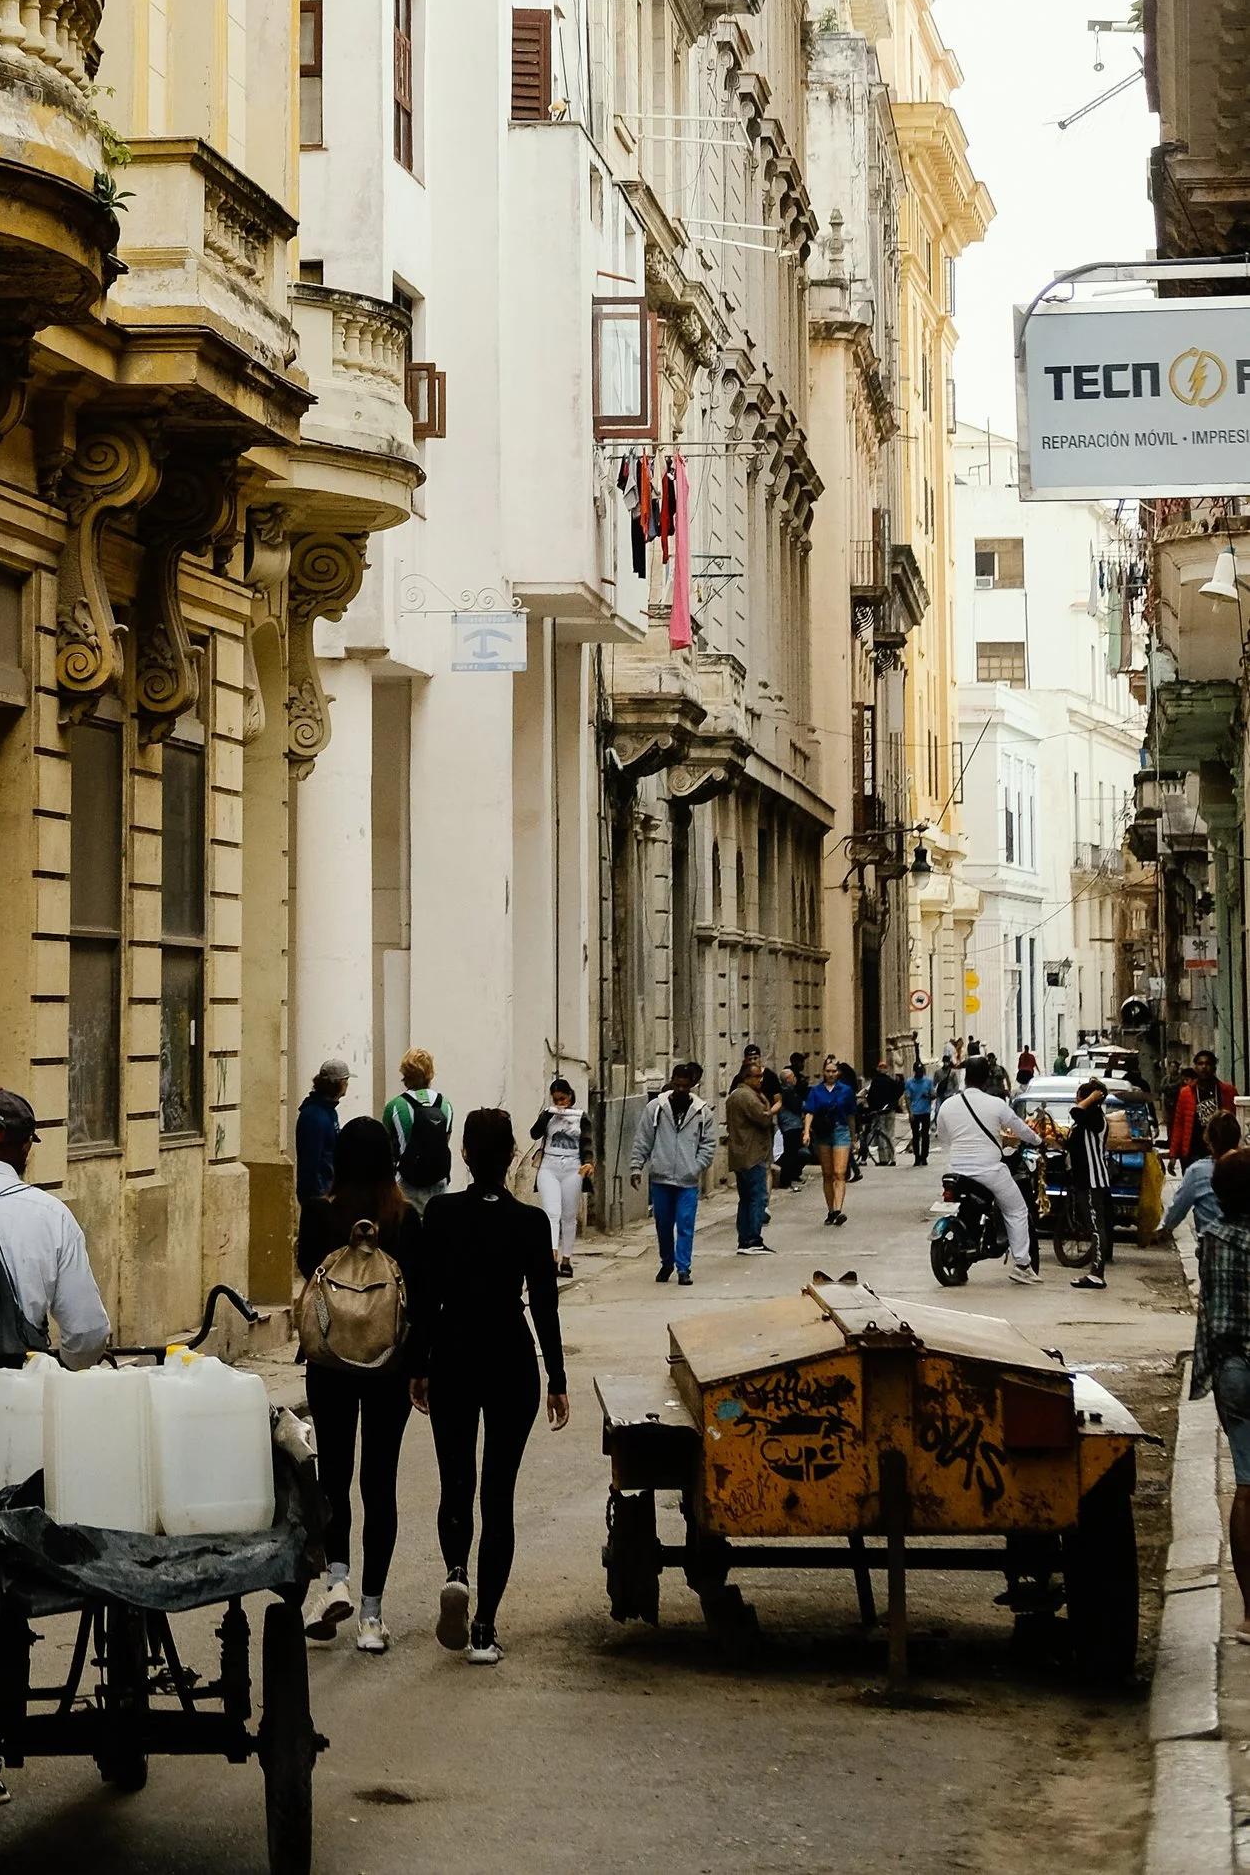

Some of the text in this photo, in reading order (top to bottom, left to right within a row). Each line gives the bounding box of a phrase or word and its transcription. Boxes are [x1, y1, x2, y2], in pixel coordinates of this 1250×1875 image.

[1042, 428, 1250, 450] REPARACIÓN MÓVIL IMPRESI
